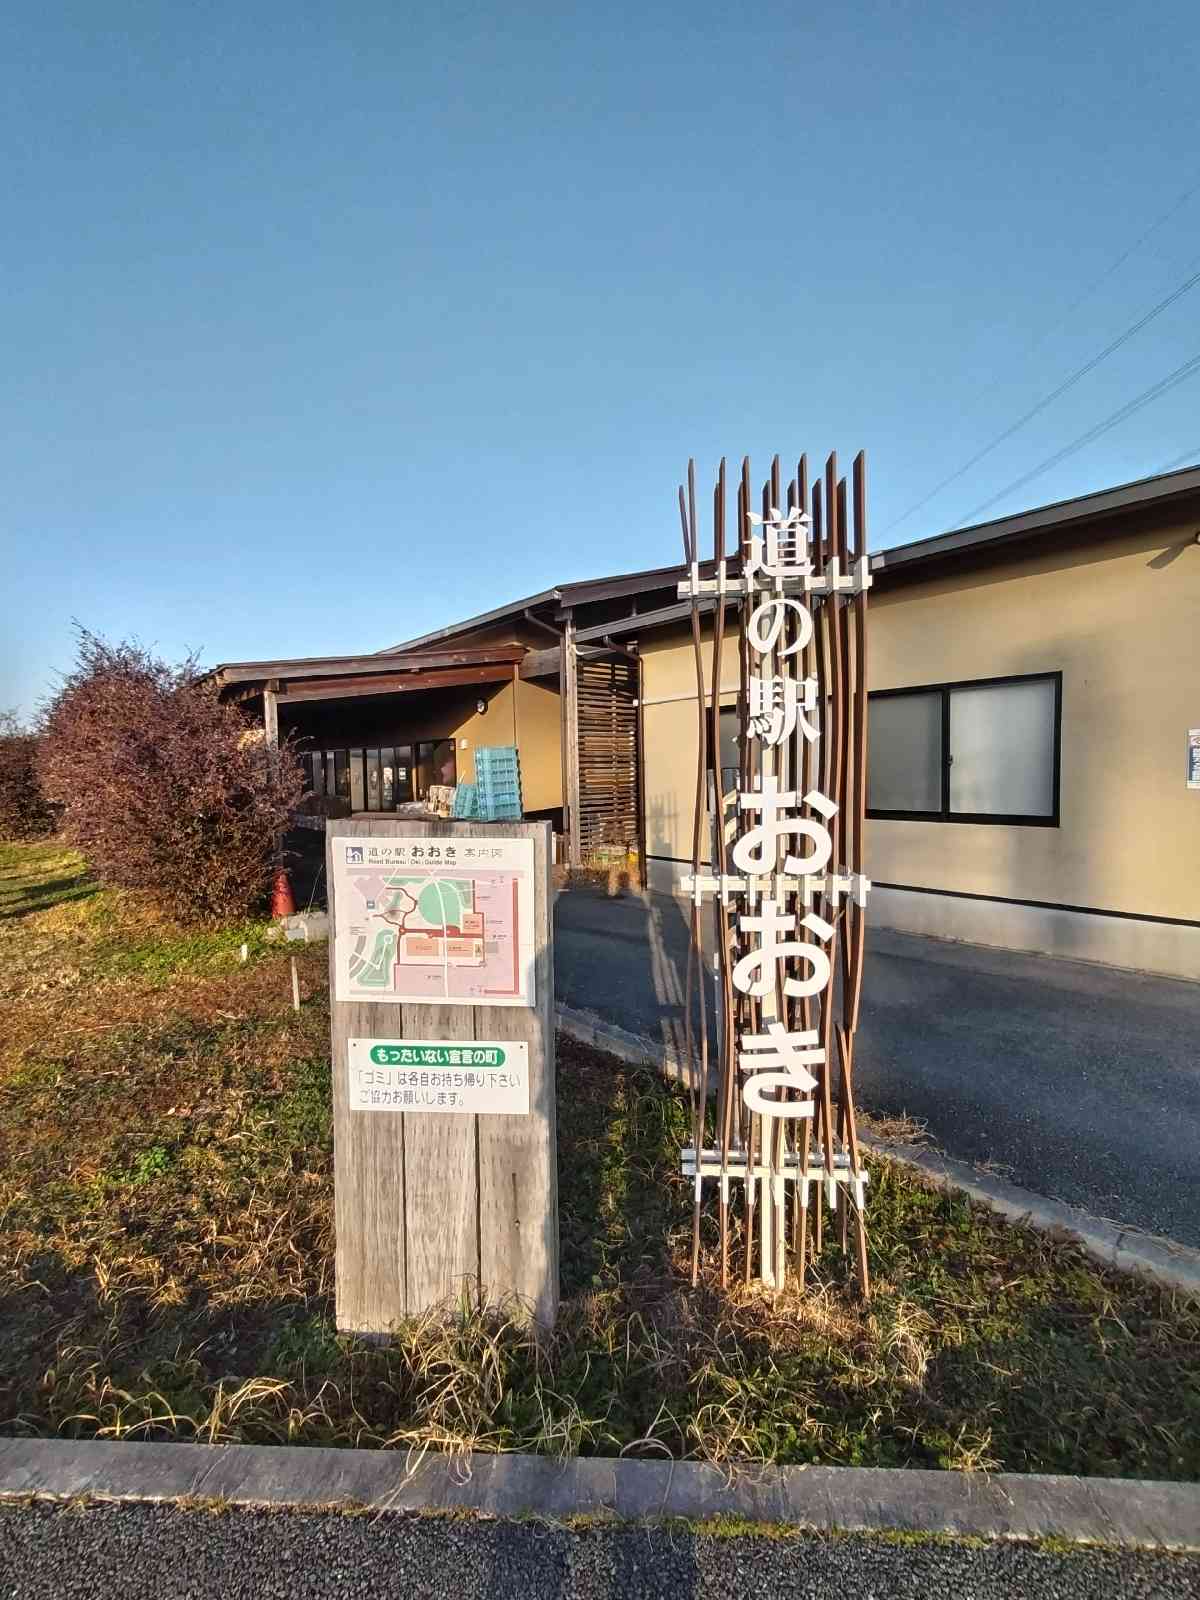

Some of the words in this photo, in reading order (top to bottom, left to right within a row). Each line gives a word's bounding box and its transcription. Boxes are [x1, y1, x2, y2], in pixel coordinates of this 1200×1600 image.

[742, 506, 821, 746] 道の駅
[368, 847, 406, 857] 道の駅
[411, 846, 457, 858] おおき
[730, 774, 840, 1120] おおき
[376, 1048, 499, 1065] もったいない宣言の町
